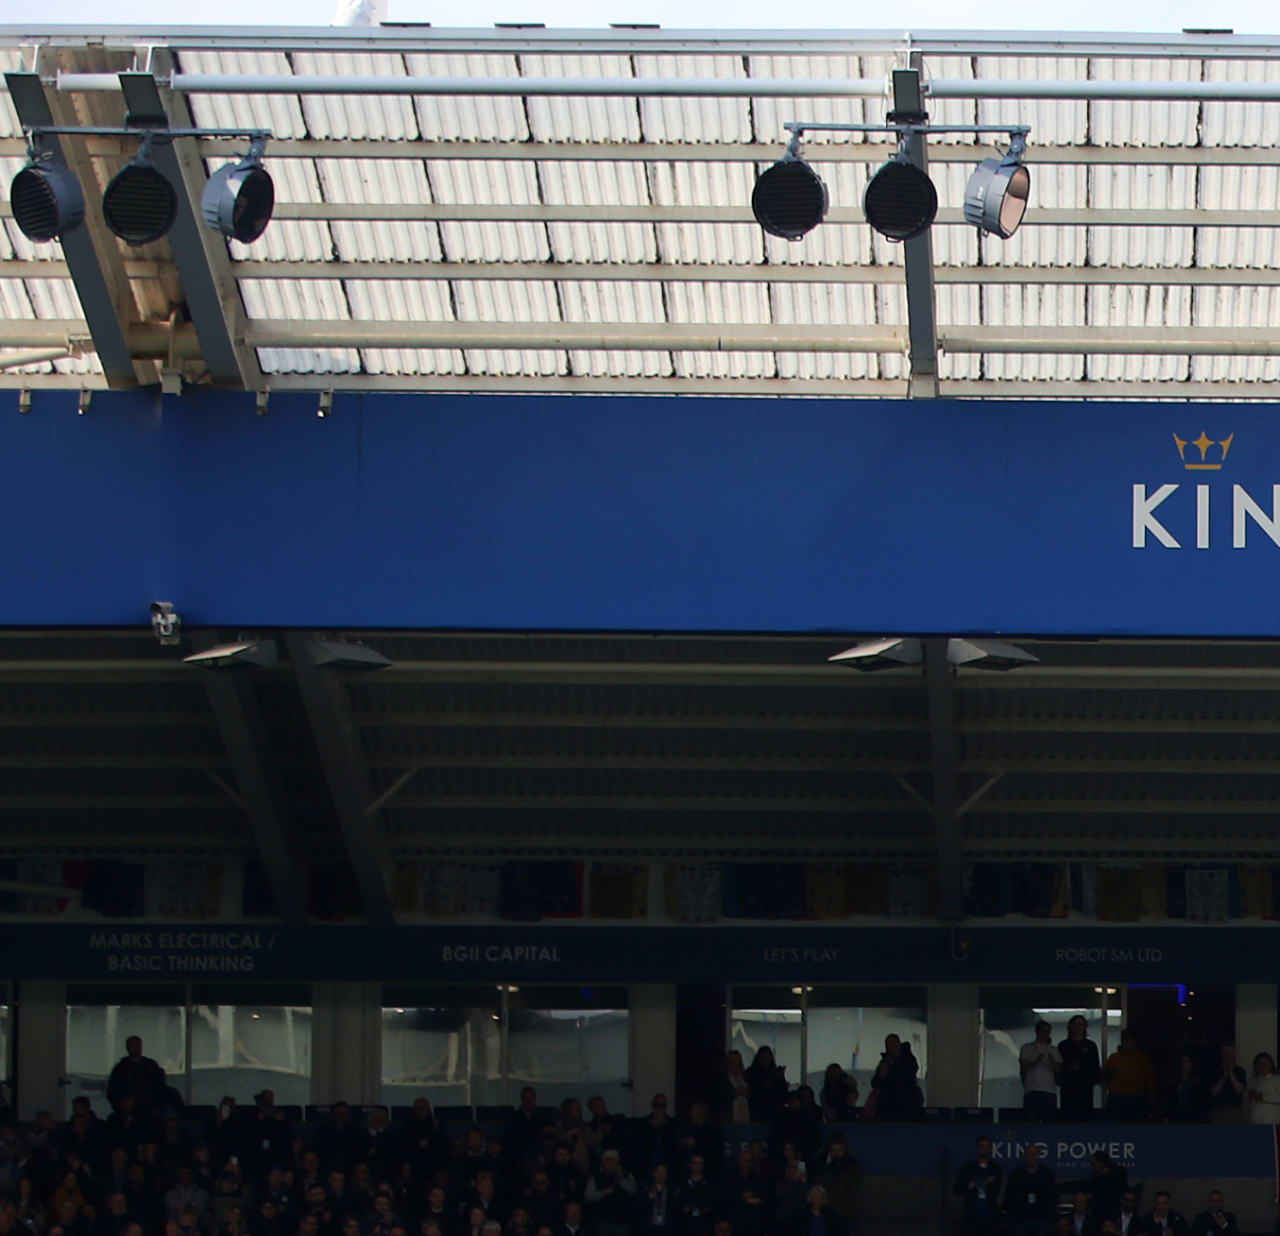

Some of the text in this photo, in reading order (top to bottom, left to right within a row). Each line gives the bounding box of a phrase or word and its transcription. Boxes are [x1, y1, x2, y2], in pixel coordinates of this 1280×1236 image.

[89, 933, 152, 950] MARKS
[158, 933, 262, 950] ELECTRICAL
[442, 946, 560, 962] BGII CAPITAL
[1056, 948, 1163, 962] ROBOT SM LTD
[108, 955, 256, 971] BASIC THINKING
[1057, 1142, 1135, 1159] POWER
